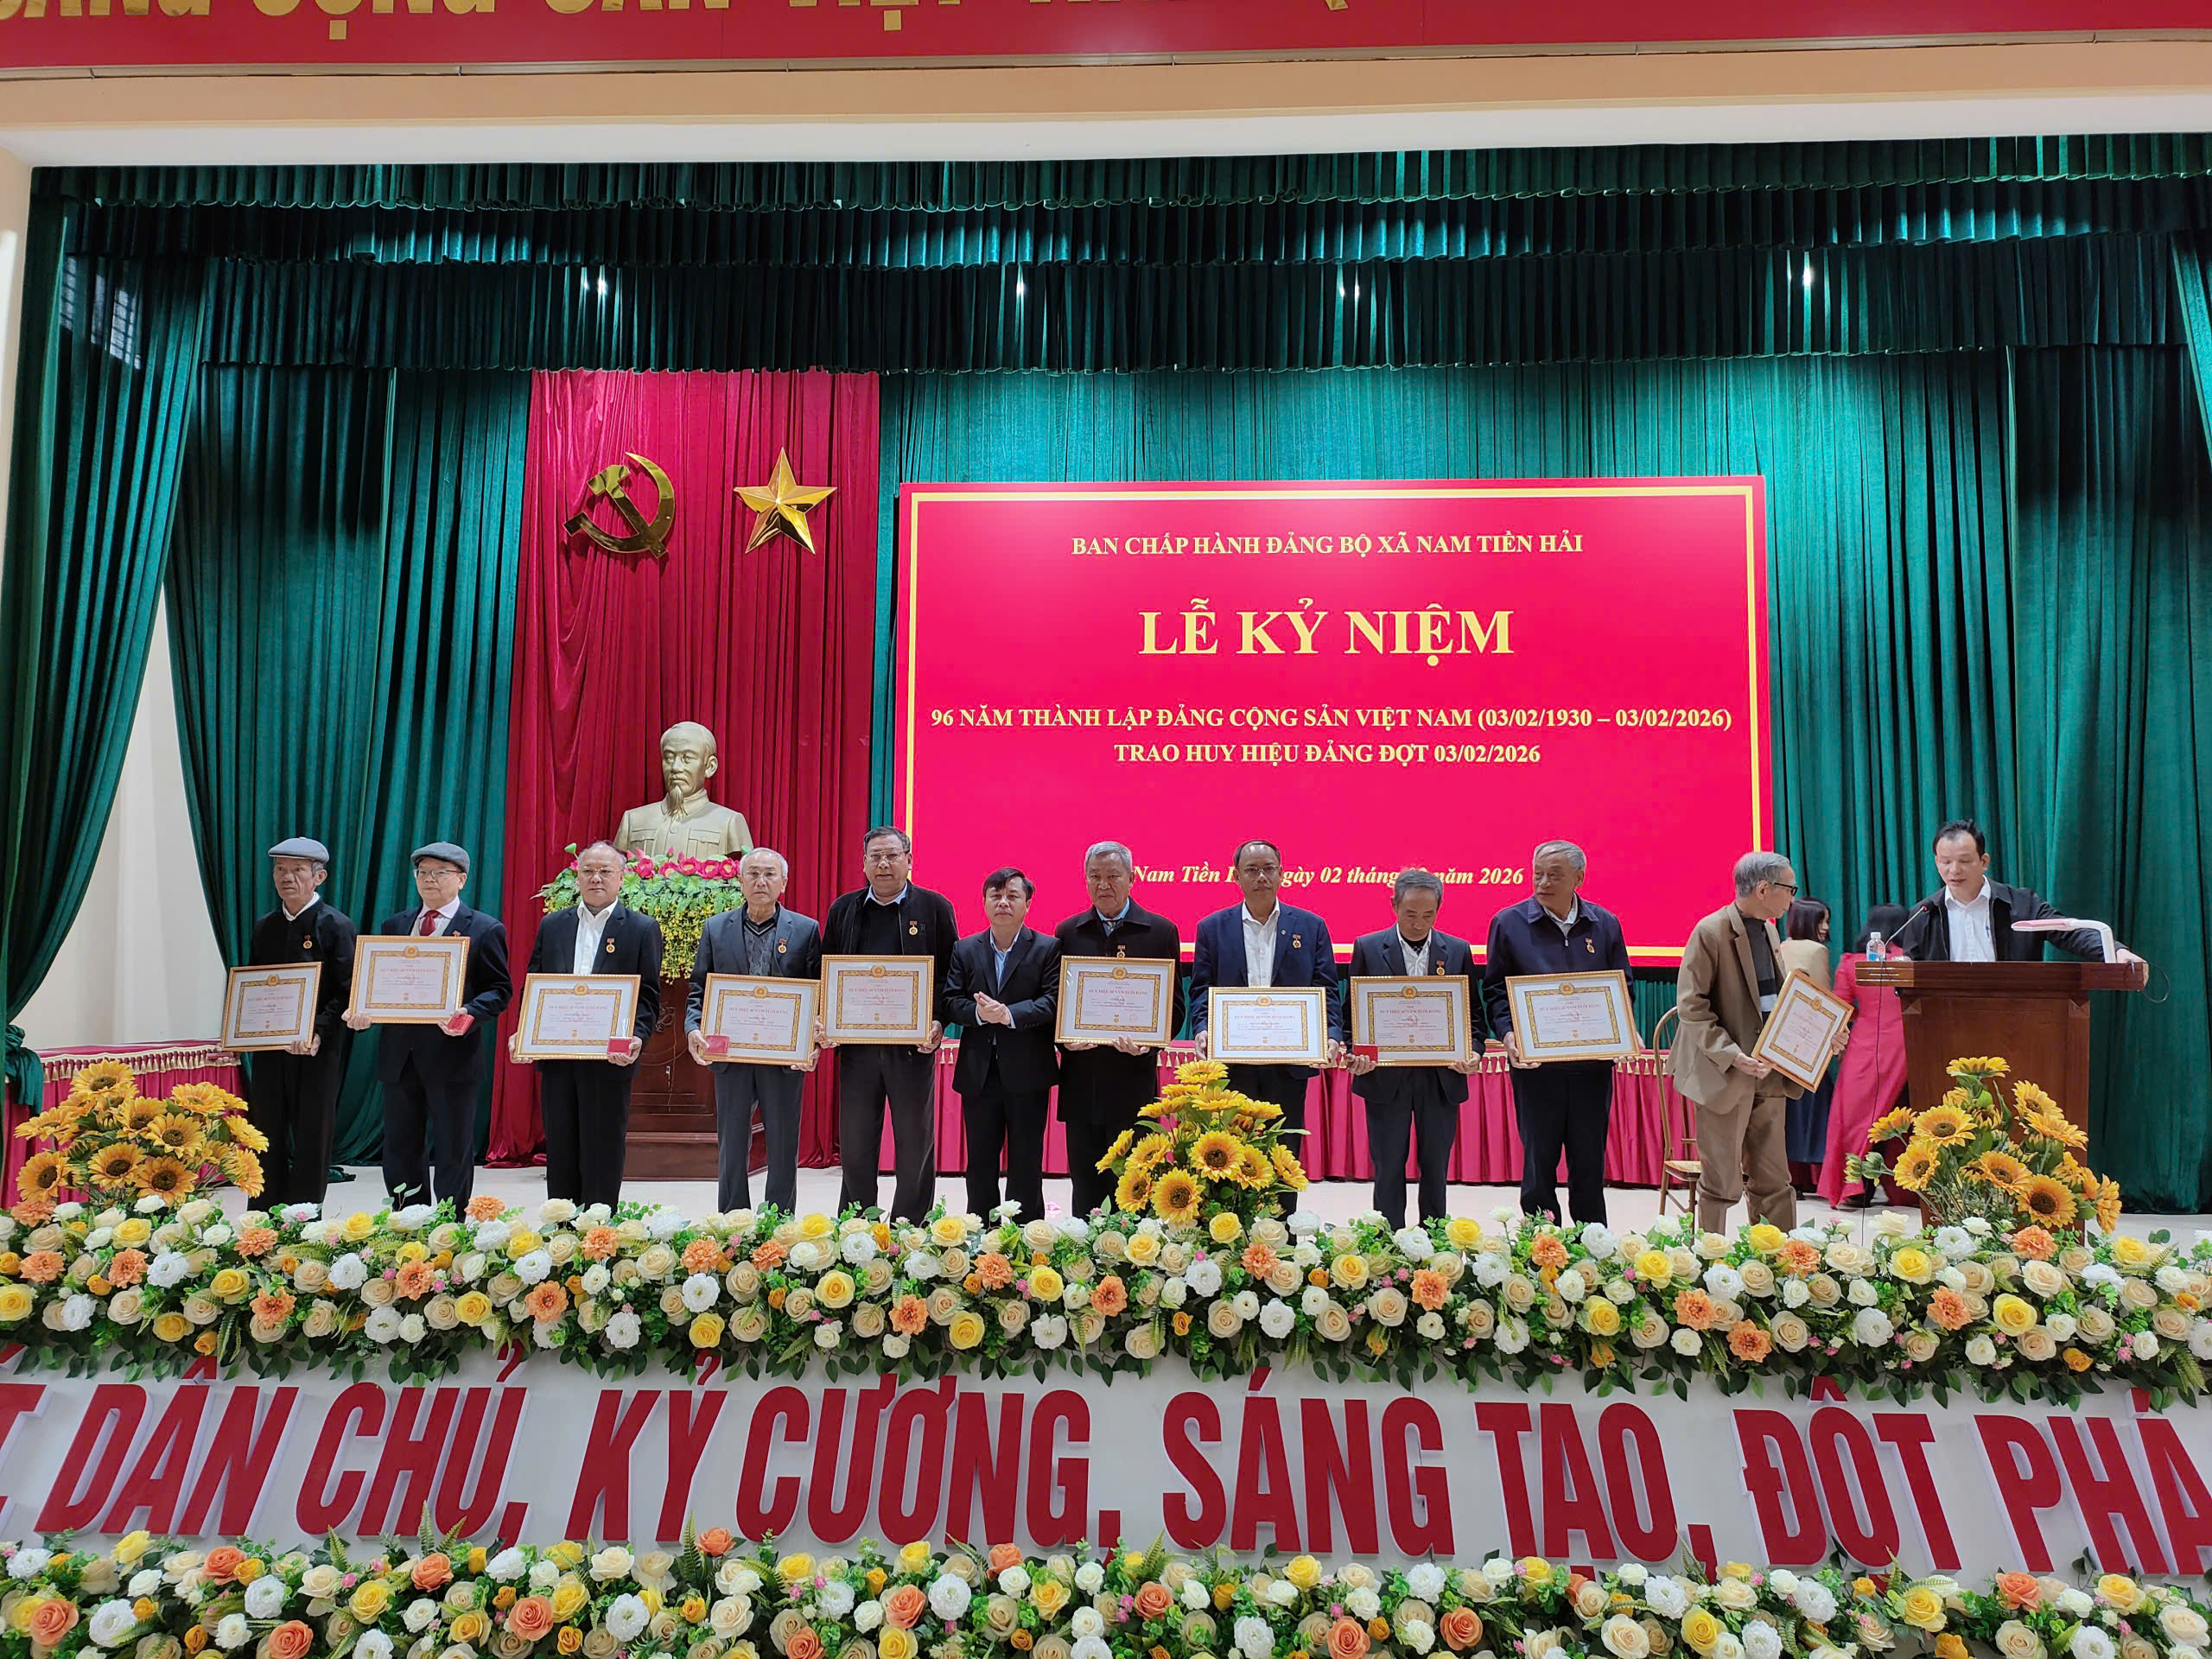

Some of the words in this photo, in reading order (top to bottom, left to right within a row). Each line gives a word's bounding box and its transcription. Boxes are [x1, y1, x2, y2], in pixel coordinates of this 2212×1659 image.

[1071, 537, 1120, 555] BAN
[1124, 531, 1189, 555] CHẤP
[1192, 531, 1261, 554] HÀNH
[1266, 531, 1334, 554] ĐẢNG
[1338, 532, 1372, 558] BỘ
[1376, 531, 1411, 554] XÃ
[1416, 535, 1471, 553] NAM
[1539, 529, 1583, 552] HẢI
[1138, 598, 1218, 654] LỄ
[1236, 597, 1328, 654] KỶ
[1344, 603, 1515, 667] NIỆM
[931, 709, 954, 727] 96
[959, 704, 1014, 727] NĂM
[1018, 703, 1101, 727] THÀNH
[1106, 705, 1153, 731] LẬP
[1156, 703, 1224, 727] ĐẢNG
[1230, 705, 1299, 731] CỘNG
[1304, 703, 1349, 727] SẢN
[1354, 705, 1412, 732] VIỆT
[1416, 709, 1472, 727] NAM
[1478, 709, 1592, 731] (03/02/1930
[1615, 709, 1732, 732] 03/02/2026)
[1113, 744, 1180, 762] TRAO
[1185, 744, 1236, 762] HUY
[1241, 741, 1300, 767] HIỆU
[1305, 740, 1373, 763] ĐẢNG
[1378, 743, 1429, 767] ĐỢT
[1433, 744, 1541, 763] 03/02/2026
[1133, 866, 1175, 882] Nam
[1181, 861, 1220, 883] Tiền
[1281, 866, 1315, 887] gày
[1319, 867, 1343, 883] 02
[1478, 868, 1524, 885] 2026
[34, 1356, 298, 1536] DÂN
[565, 1349, 728, 1541] KỶ
[1163, 1368, 1454, 1555] SÁNG
[1734, 1377, 1961, 1591] ĐỘT
